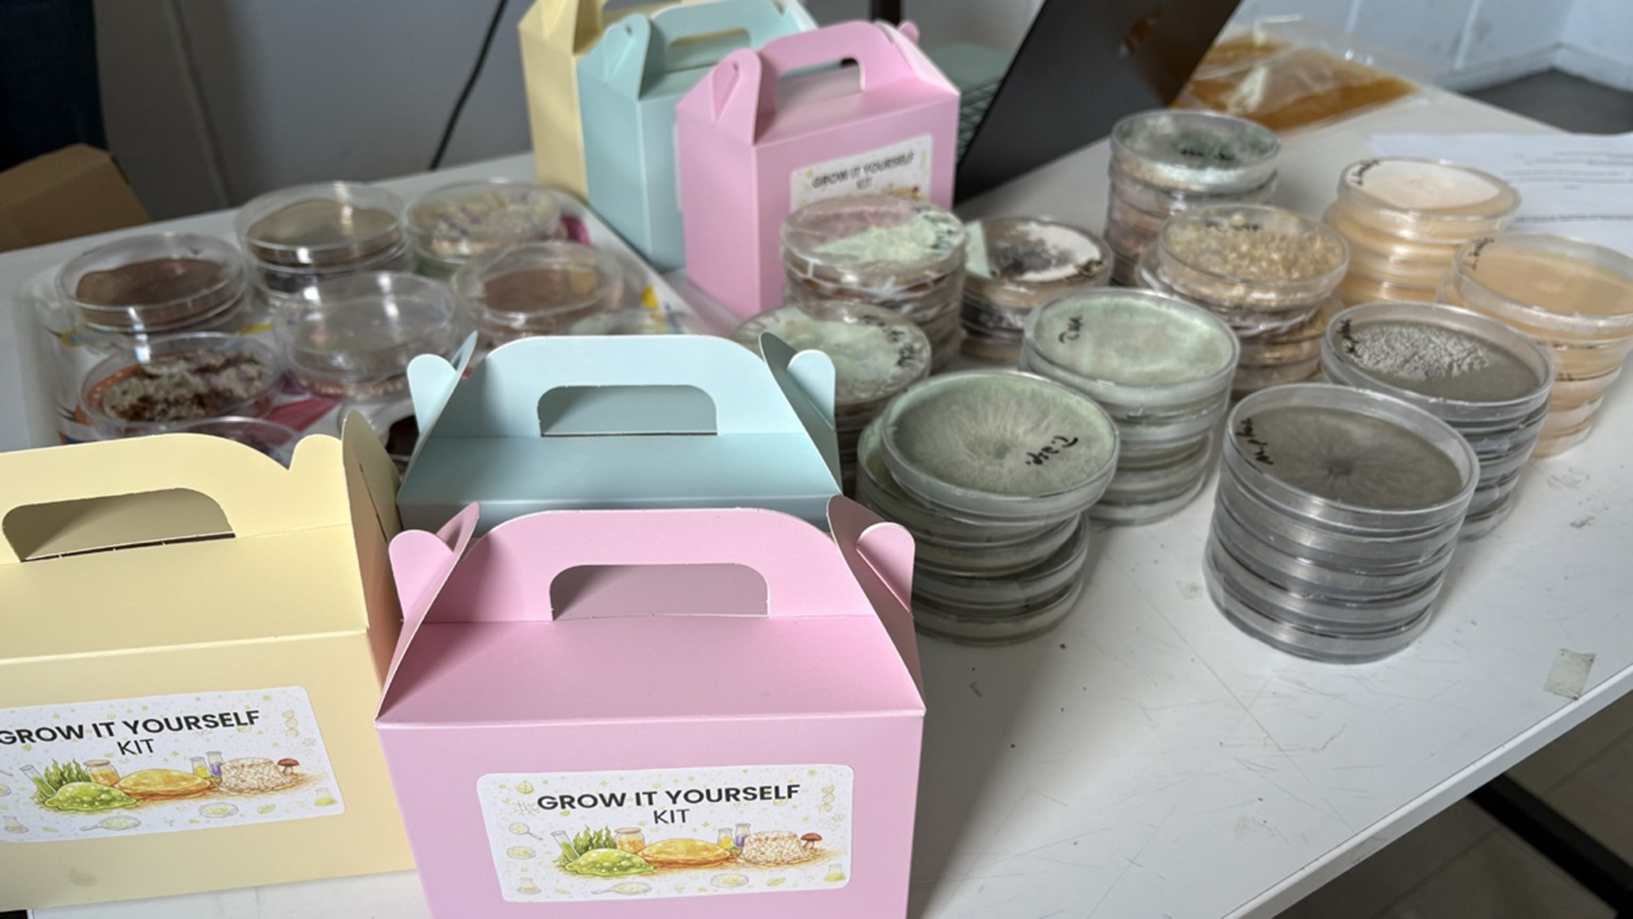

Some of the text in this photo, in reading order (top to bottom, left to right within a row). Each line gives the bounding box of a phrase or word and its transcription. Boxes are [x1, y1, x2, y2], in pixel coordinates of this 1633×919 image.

[0, 710, 261, 746] GROW IT YOURSELF
[117, 738, 155, 756] KIT
[537, 784, 801, 811] GROW IT YOURSELF
[653, 809, 691, 825] KIT
